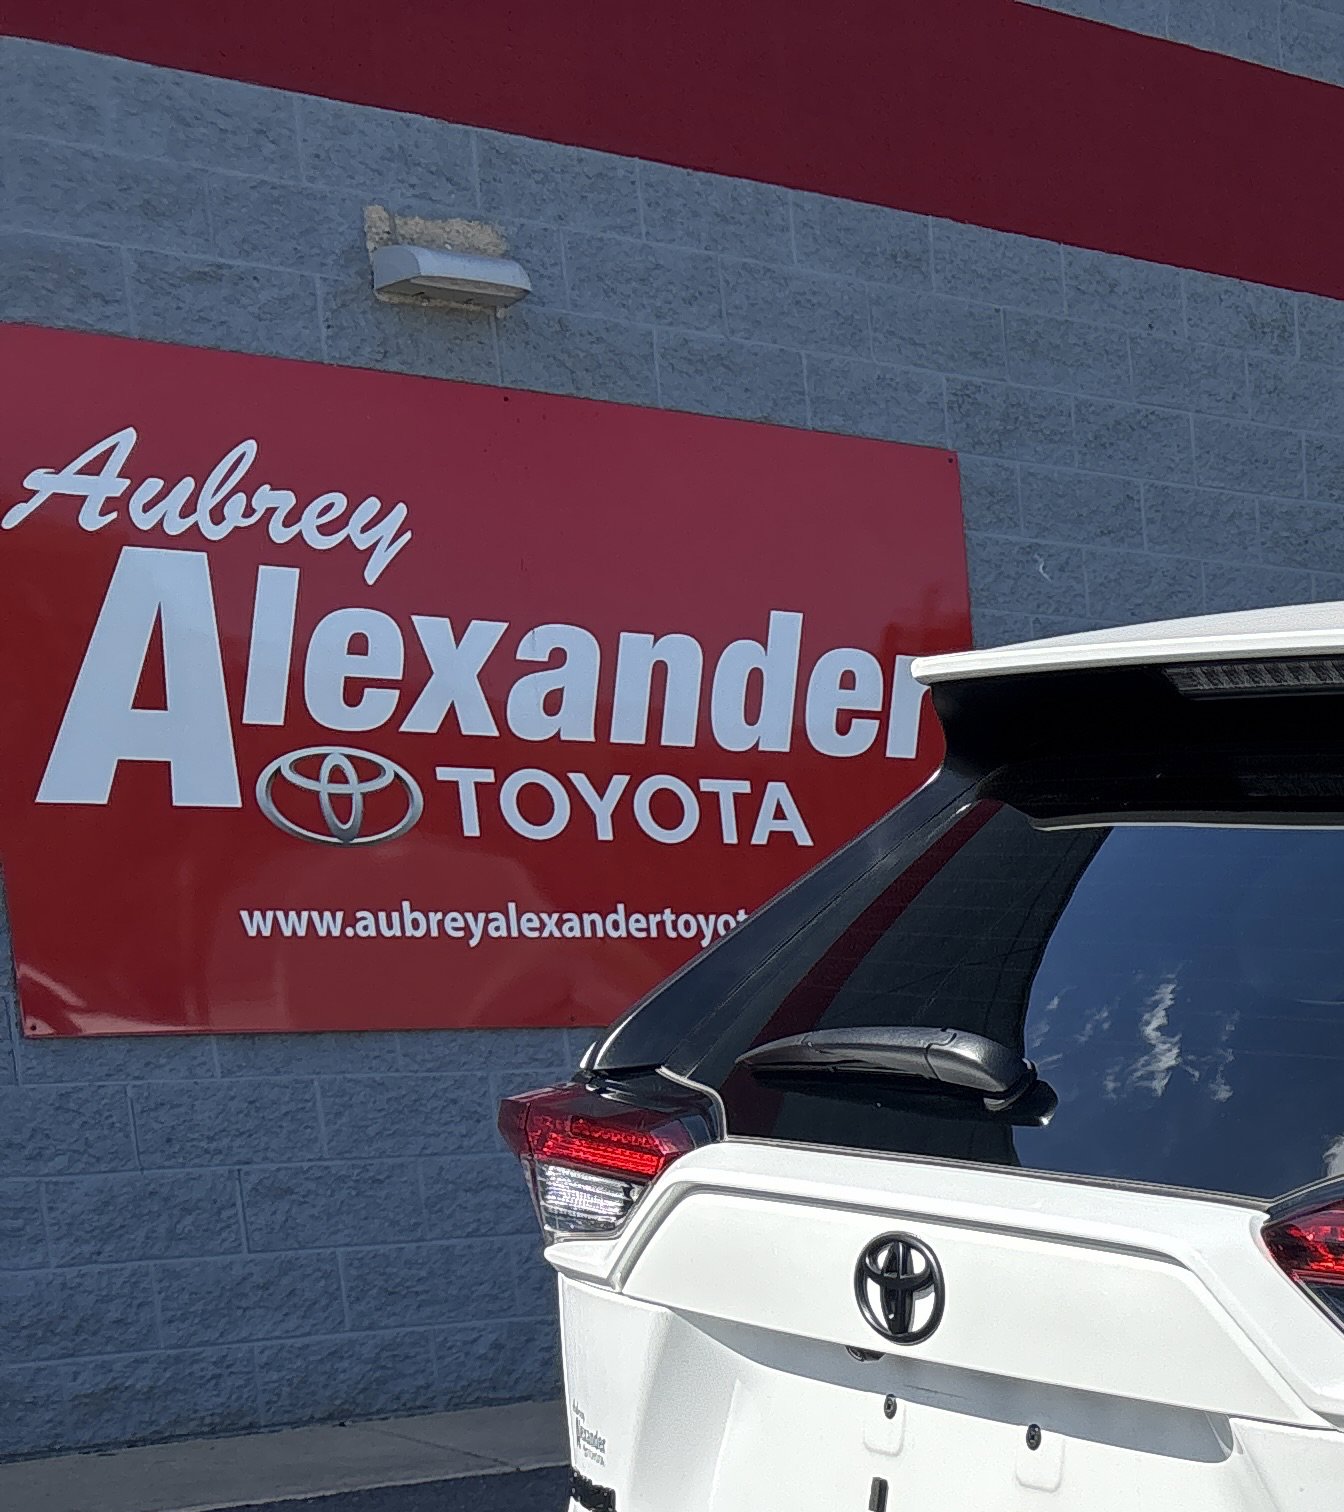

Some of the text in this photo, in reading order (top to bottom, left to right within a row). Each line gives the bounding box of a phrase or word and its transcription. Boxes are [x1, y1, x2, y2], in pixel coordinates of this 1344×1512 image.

[1, 426, 412, 585] Aubrey
[34, 545, 932, 809] Alexander
[435, 766, 815, 847] TOYOTA
